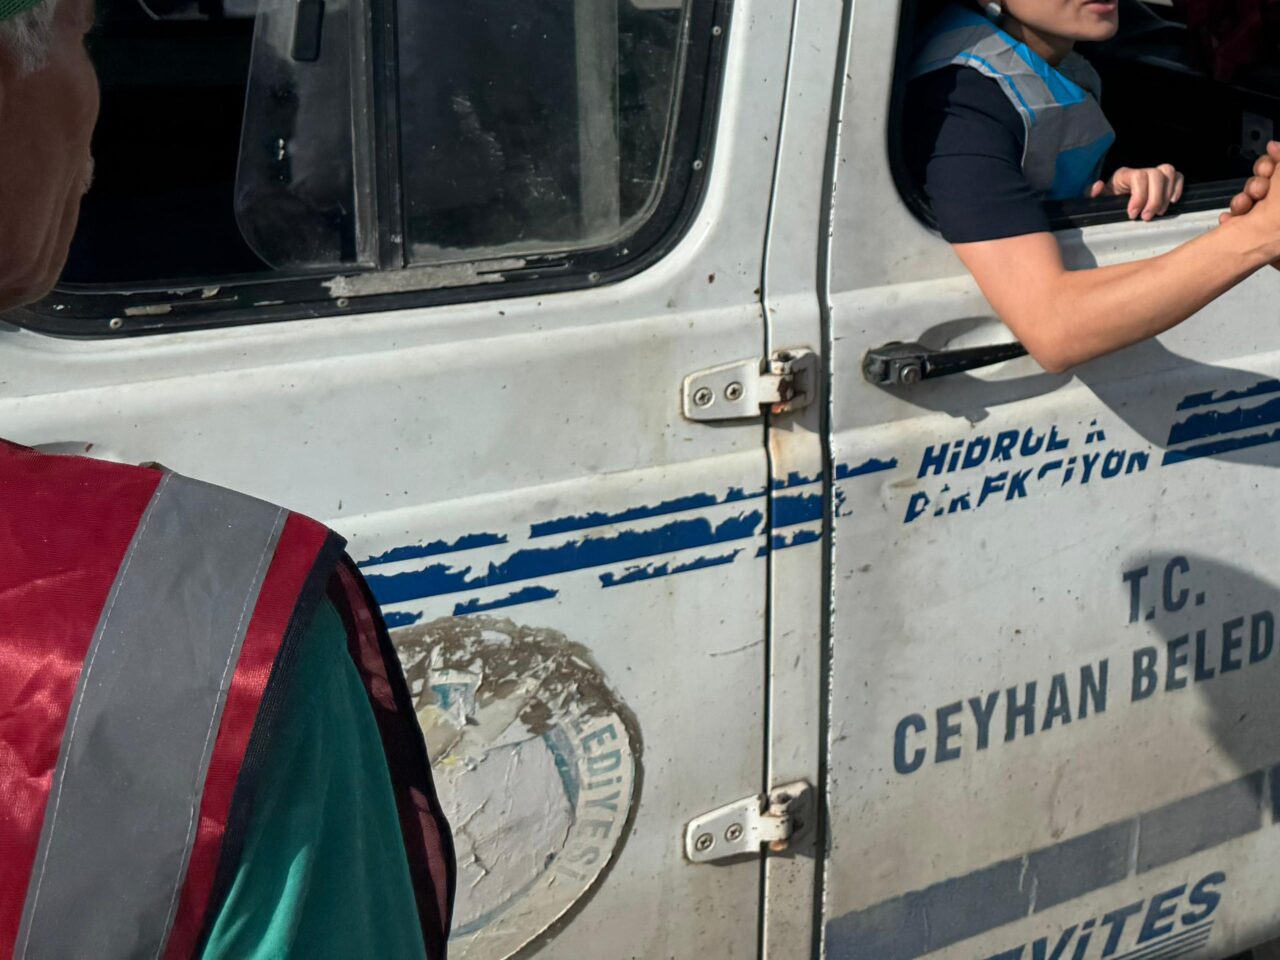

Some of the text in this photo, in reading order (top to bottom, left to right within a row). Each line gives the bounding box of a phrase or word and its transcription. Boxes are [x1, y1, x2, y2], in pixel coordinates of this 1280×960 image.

[1122, 555, 1206, 624] T.C.
[893, 657, 1109, 775] CEYHAN
[982, 870, 1226, 960] ViTES
